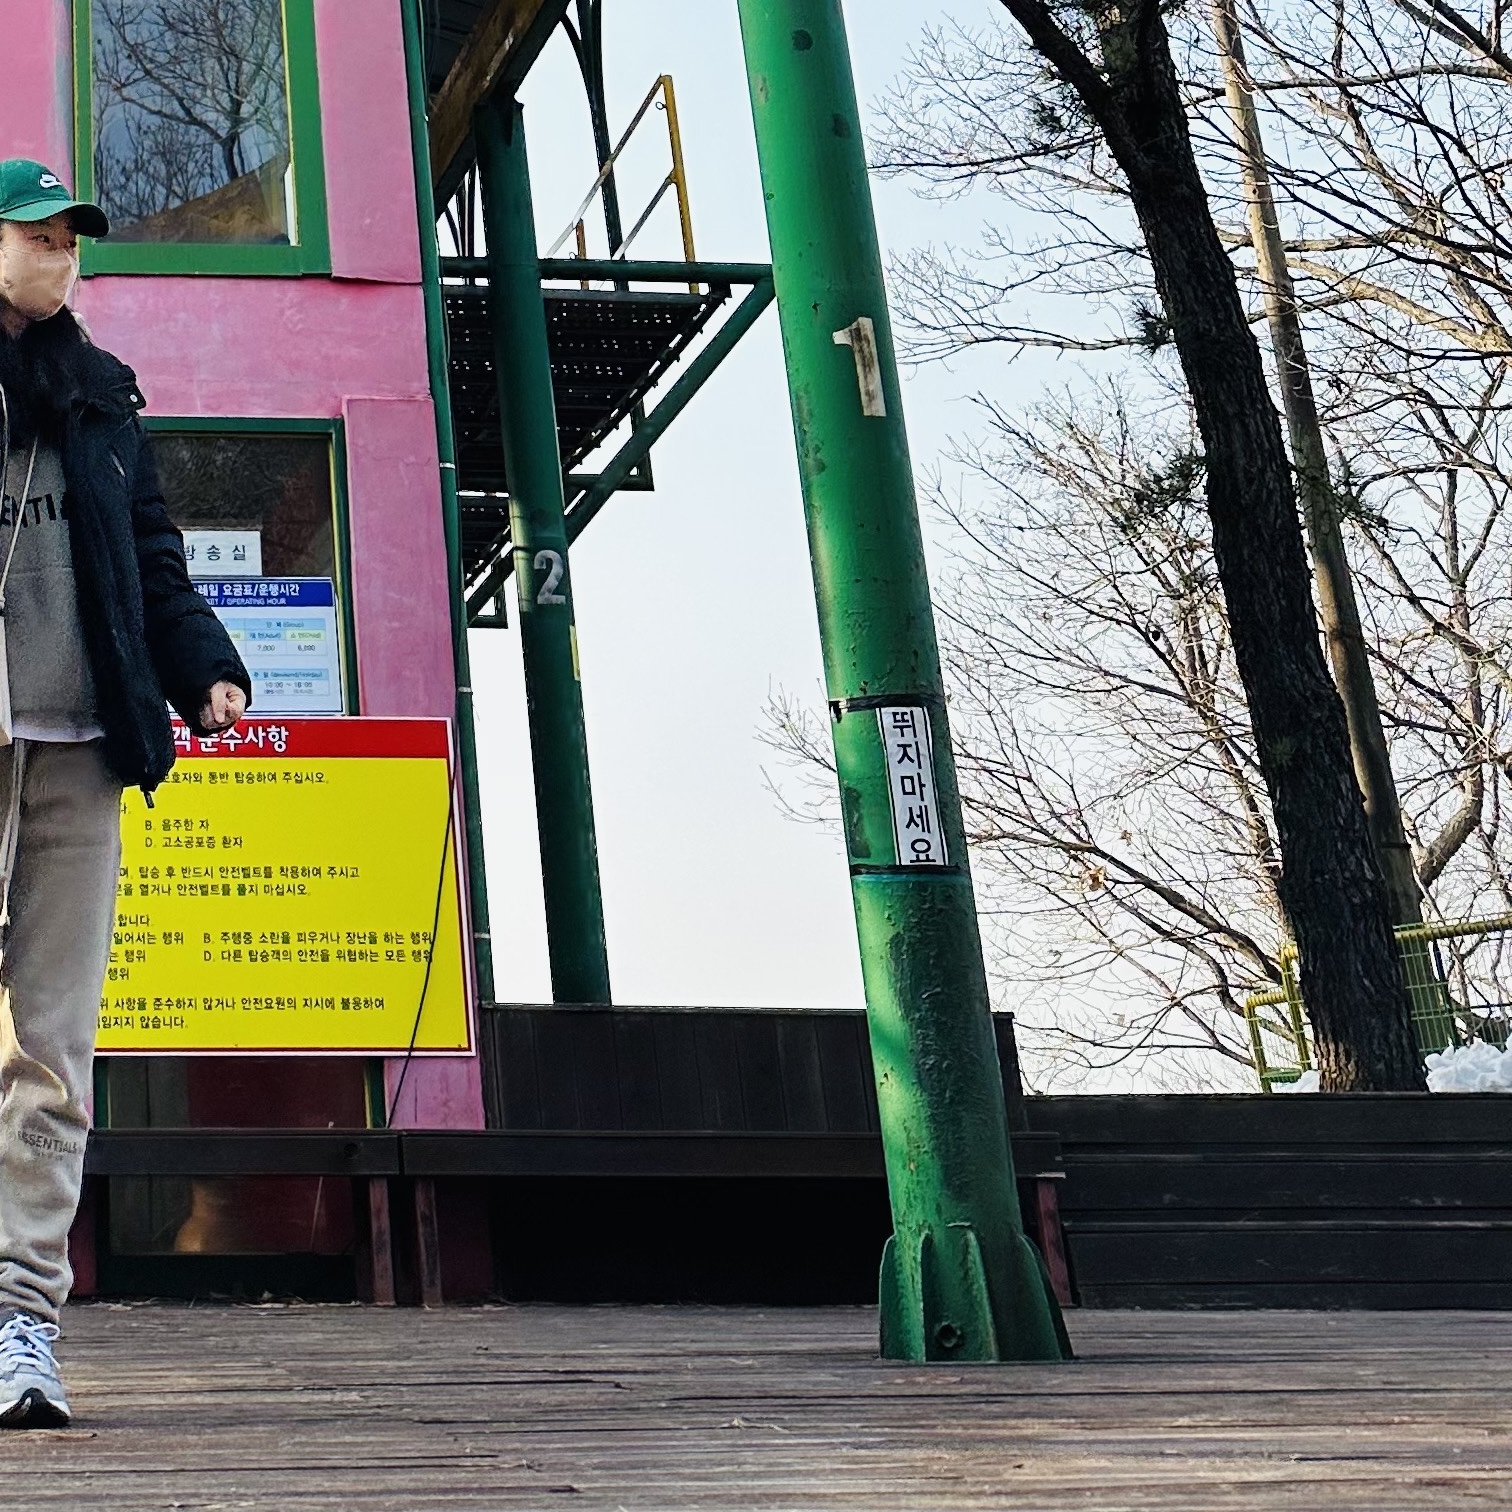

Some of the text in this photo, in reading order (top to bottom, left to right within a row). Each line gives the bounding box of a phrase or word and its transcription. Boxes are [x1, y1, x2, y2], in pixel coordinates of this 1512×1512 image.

[832, 316, 887, 418] 1
[533, 549, 567, 605] 2
[193, 584, 219, 597] 레일
[891, 709, 937, 864] 뛰지마세요
[199, 819, 210, 831] 자
[138, 866, 160, 879] 탑승
[165, 866, 176, 879] 후
[181, 866, 214, 879] 반드시
[218, 866, 273, 879] 안전벨트를
[279, 866, 322, 879] 착용하여
[326, 866, 360, 879] 주시고
[162, 931, 184, 945] 행위
[220, 931, 254, 945] 주행중
[296, 931, 341, 945] 피우거나
[383, 931, 405, 945] 하는
[124, 949, 146, 963] 행위
[221, 949, 243, 962] 다른
[248, 949, 292, 963] 탑승객의
[297, 949, 330, 963] 안전을
[153, 997, 198, 1010] 준수하지
[241, 997, 297, 1010] 안전요원의
[302, 997, 336, 1010] 지시에
